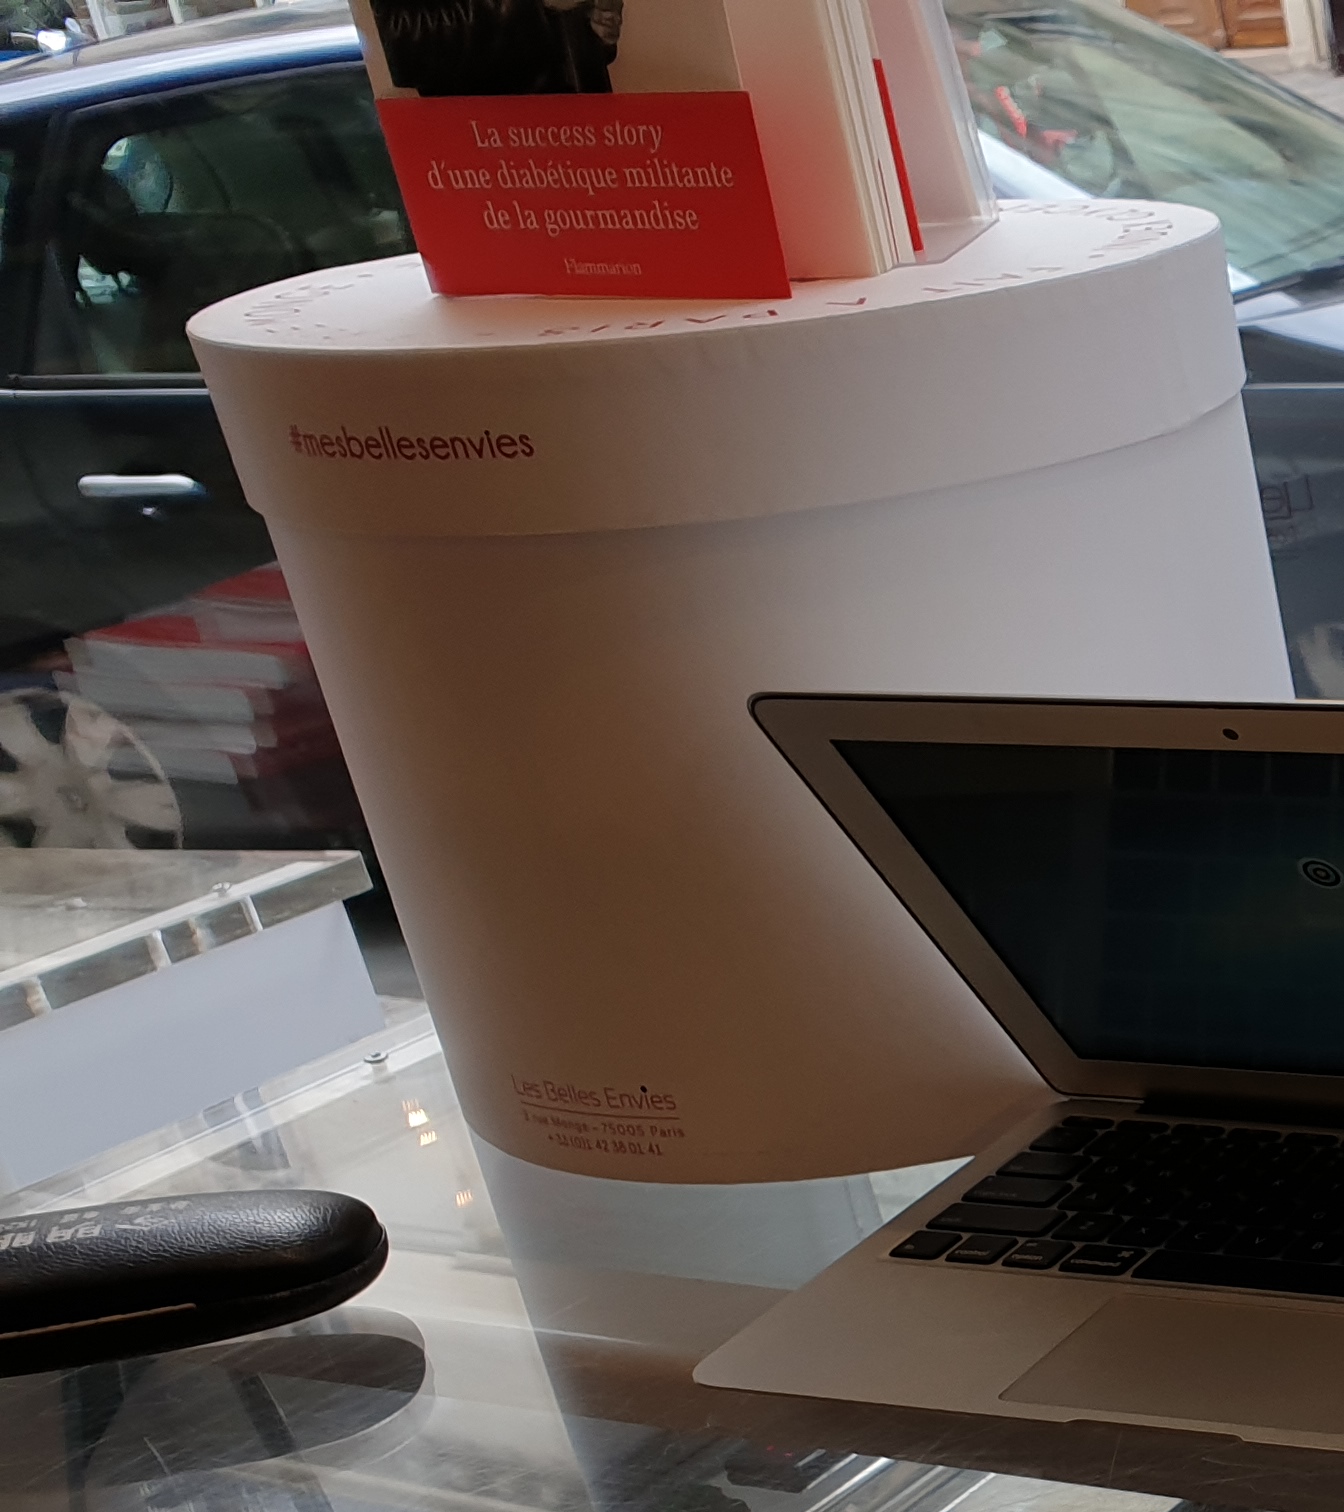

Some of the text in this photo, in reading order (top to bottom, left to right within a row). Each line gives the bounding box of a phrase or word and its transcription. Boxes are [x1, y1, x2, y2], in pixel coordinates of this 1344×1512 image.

[468, 118, 663, 154] La success story
[427, 157, 735, 196] d'une diabétique militante
[483, 200, 700, 237] de la gourmandise
[563, 257, 643, 277] Flammarion
[288, 424, 536, 461] #mesbellesenvies
[510, 1074, 678, 1112] Les Belles Envies
[601, 1122, 645, 1138] 75005
[650, 1125, 686, 1139] Paris
